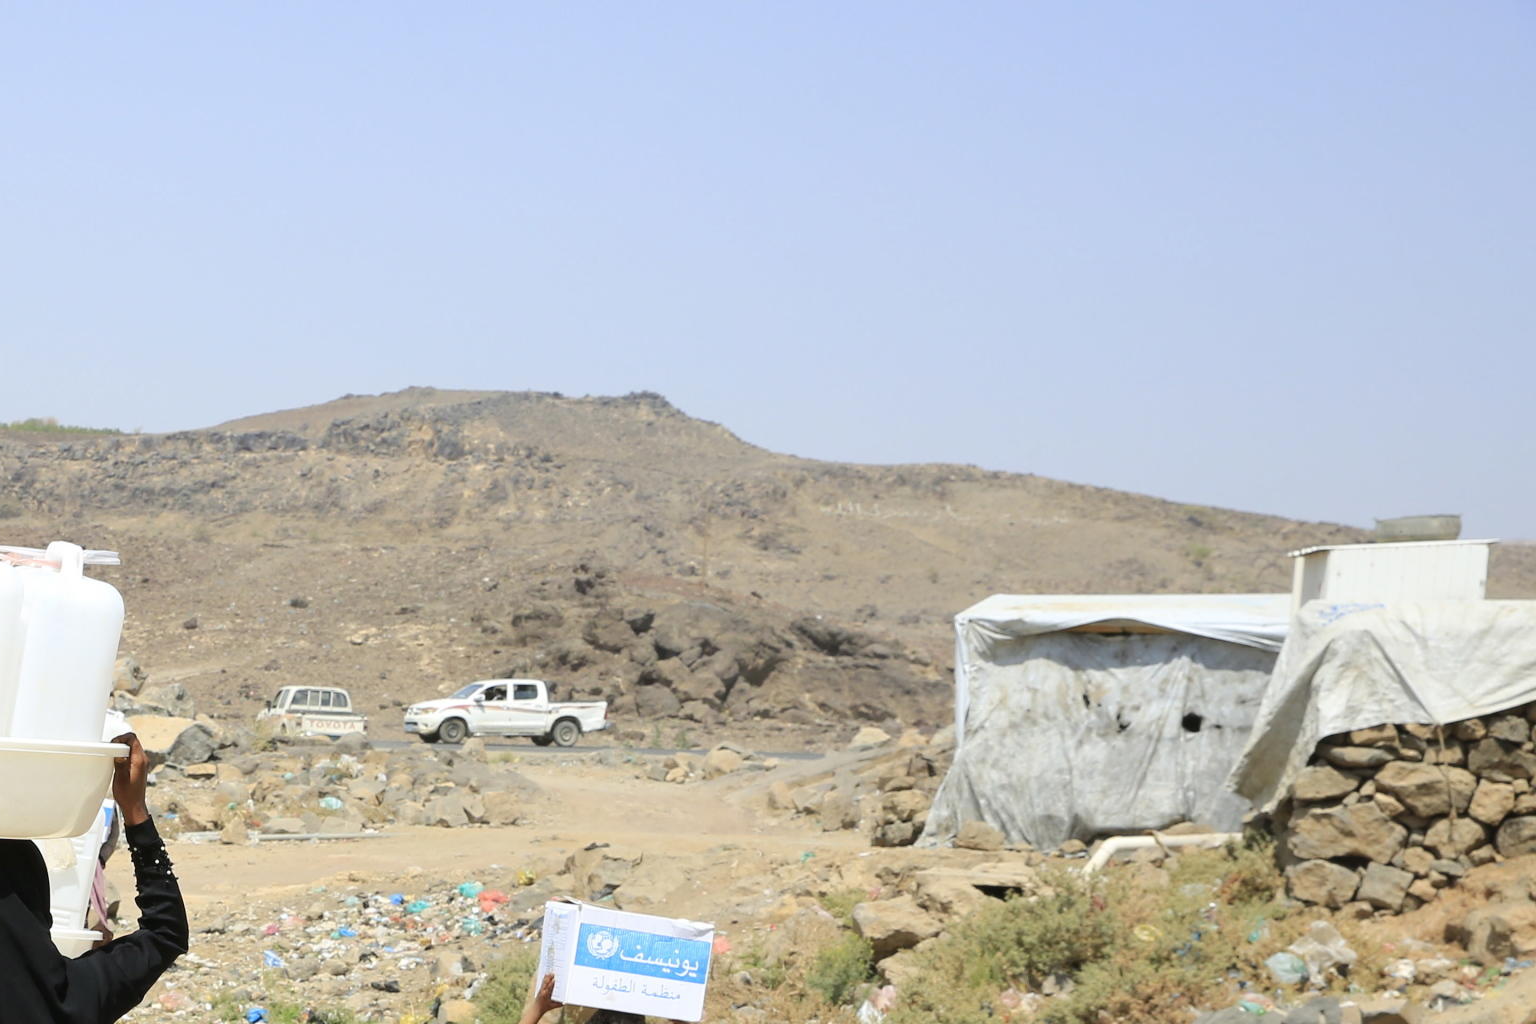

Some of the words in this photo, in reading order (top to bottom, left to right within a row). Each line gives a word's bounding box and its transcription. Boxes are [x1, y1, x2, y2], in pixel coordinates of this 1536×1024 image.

[308, 719, 356, 730] TOYOTA
[619, 944, 699, 978] يونيسف
[592, 975, 636, 996] الطفولة
[640, 982, 681, 1000] منظمة
